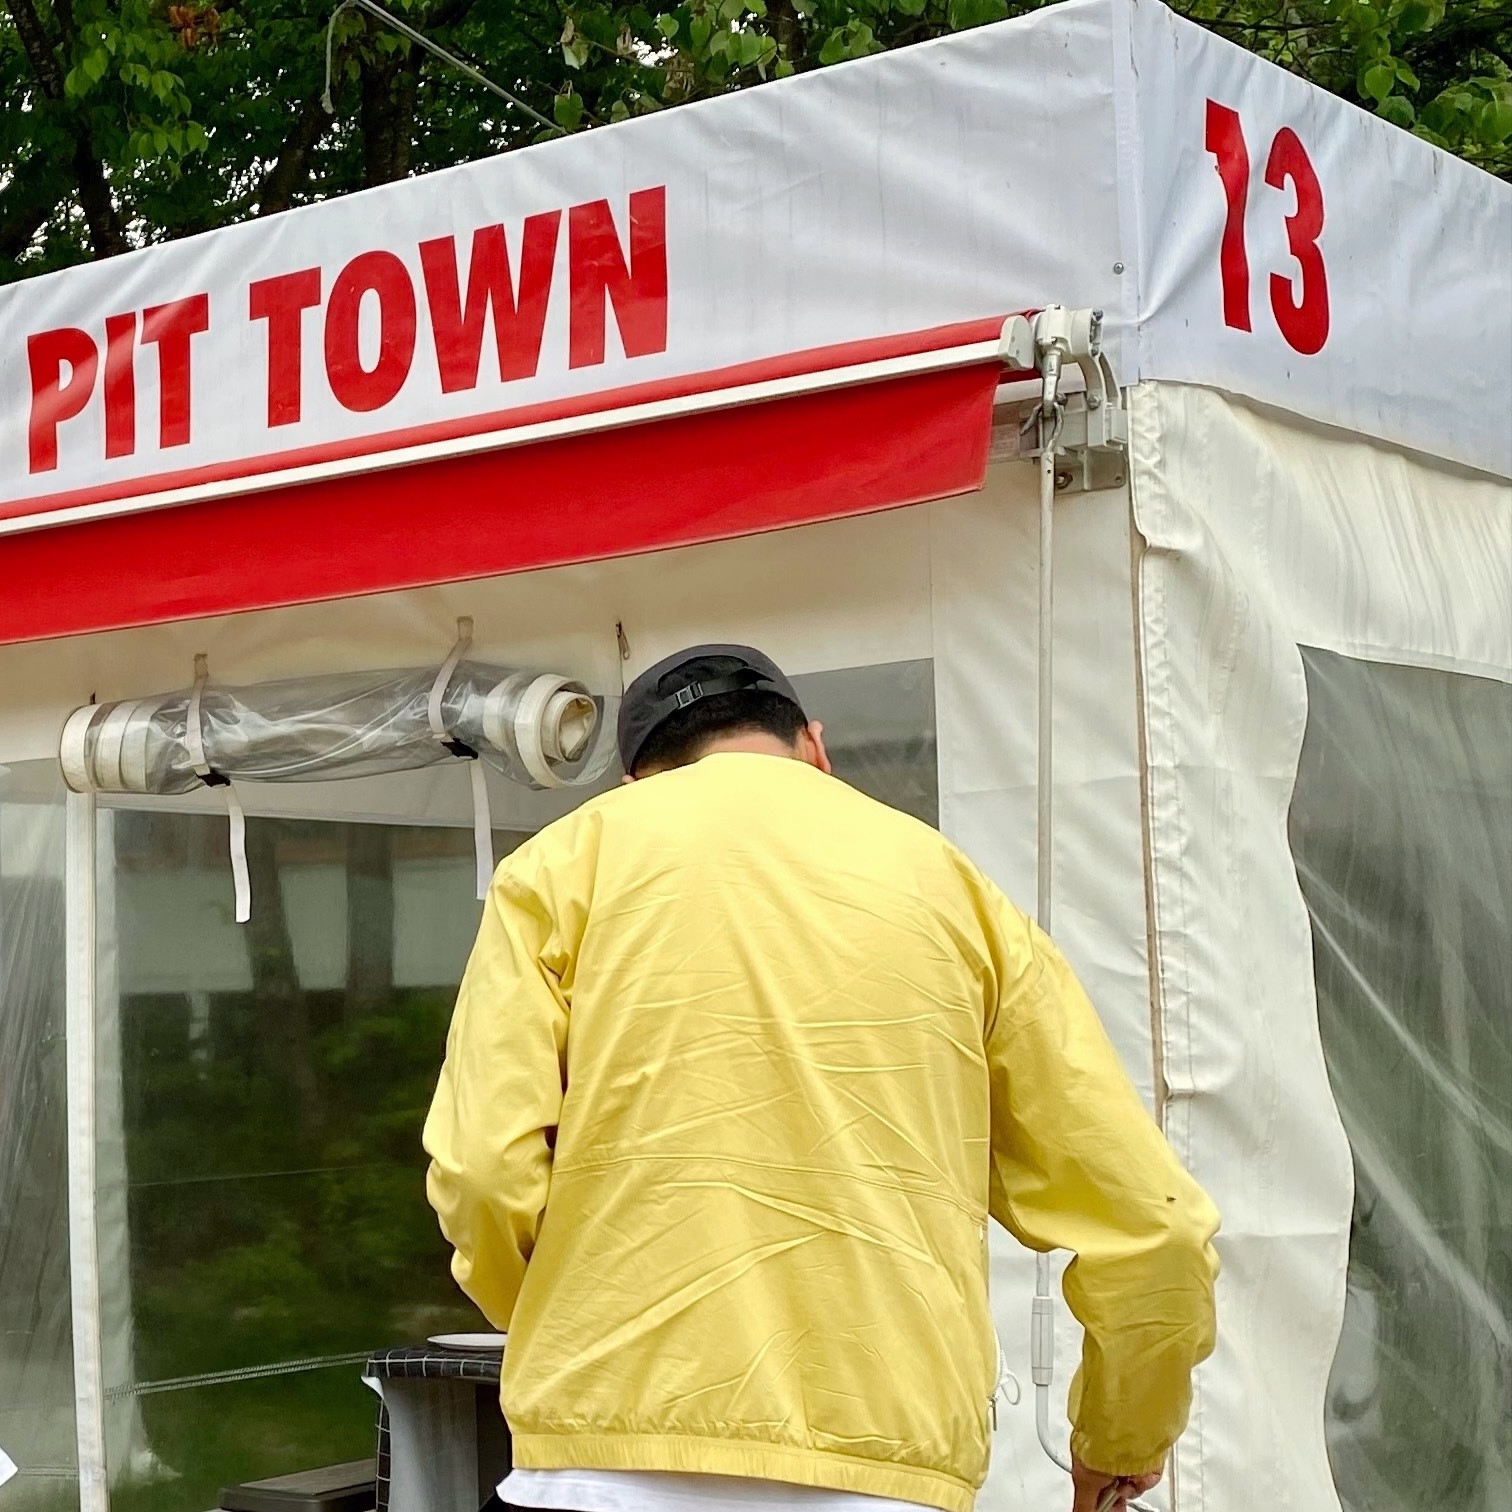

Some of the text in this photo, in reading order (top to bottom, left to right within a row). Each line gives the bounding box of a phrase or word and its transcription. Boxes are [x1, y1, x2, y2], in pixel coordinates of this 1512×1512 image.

[28, 186, 667, 474] PIT TOWN
[1206, 98, 1330, 355] 13
